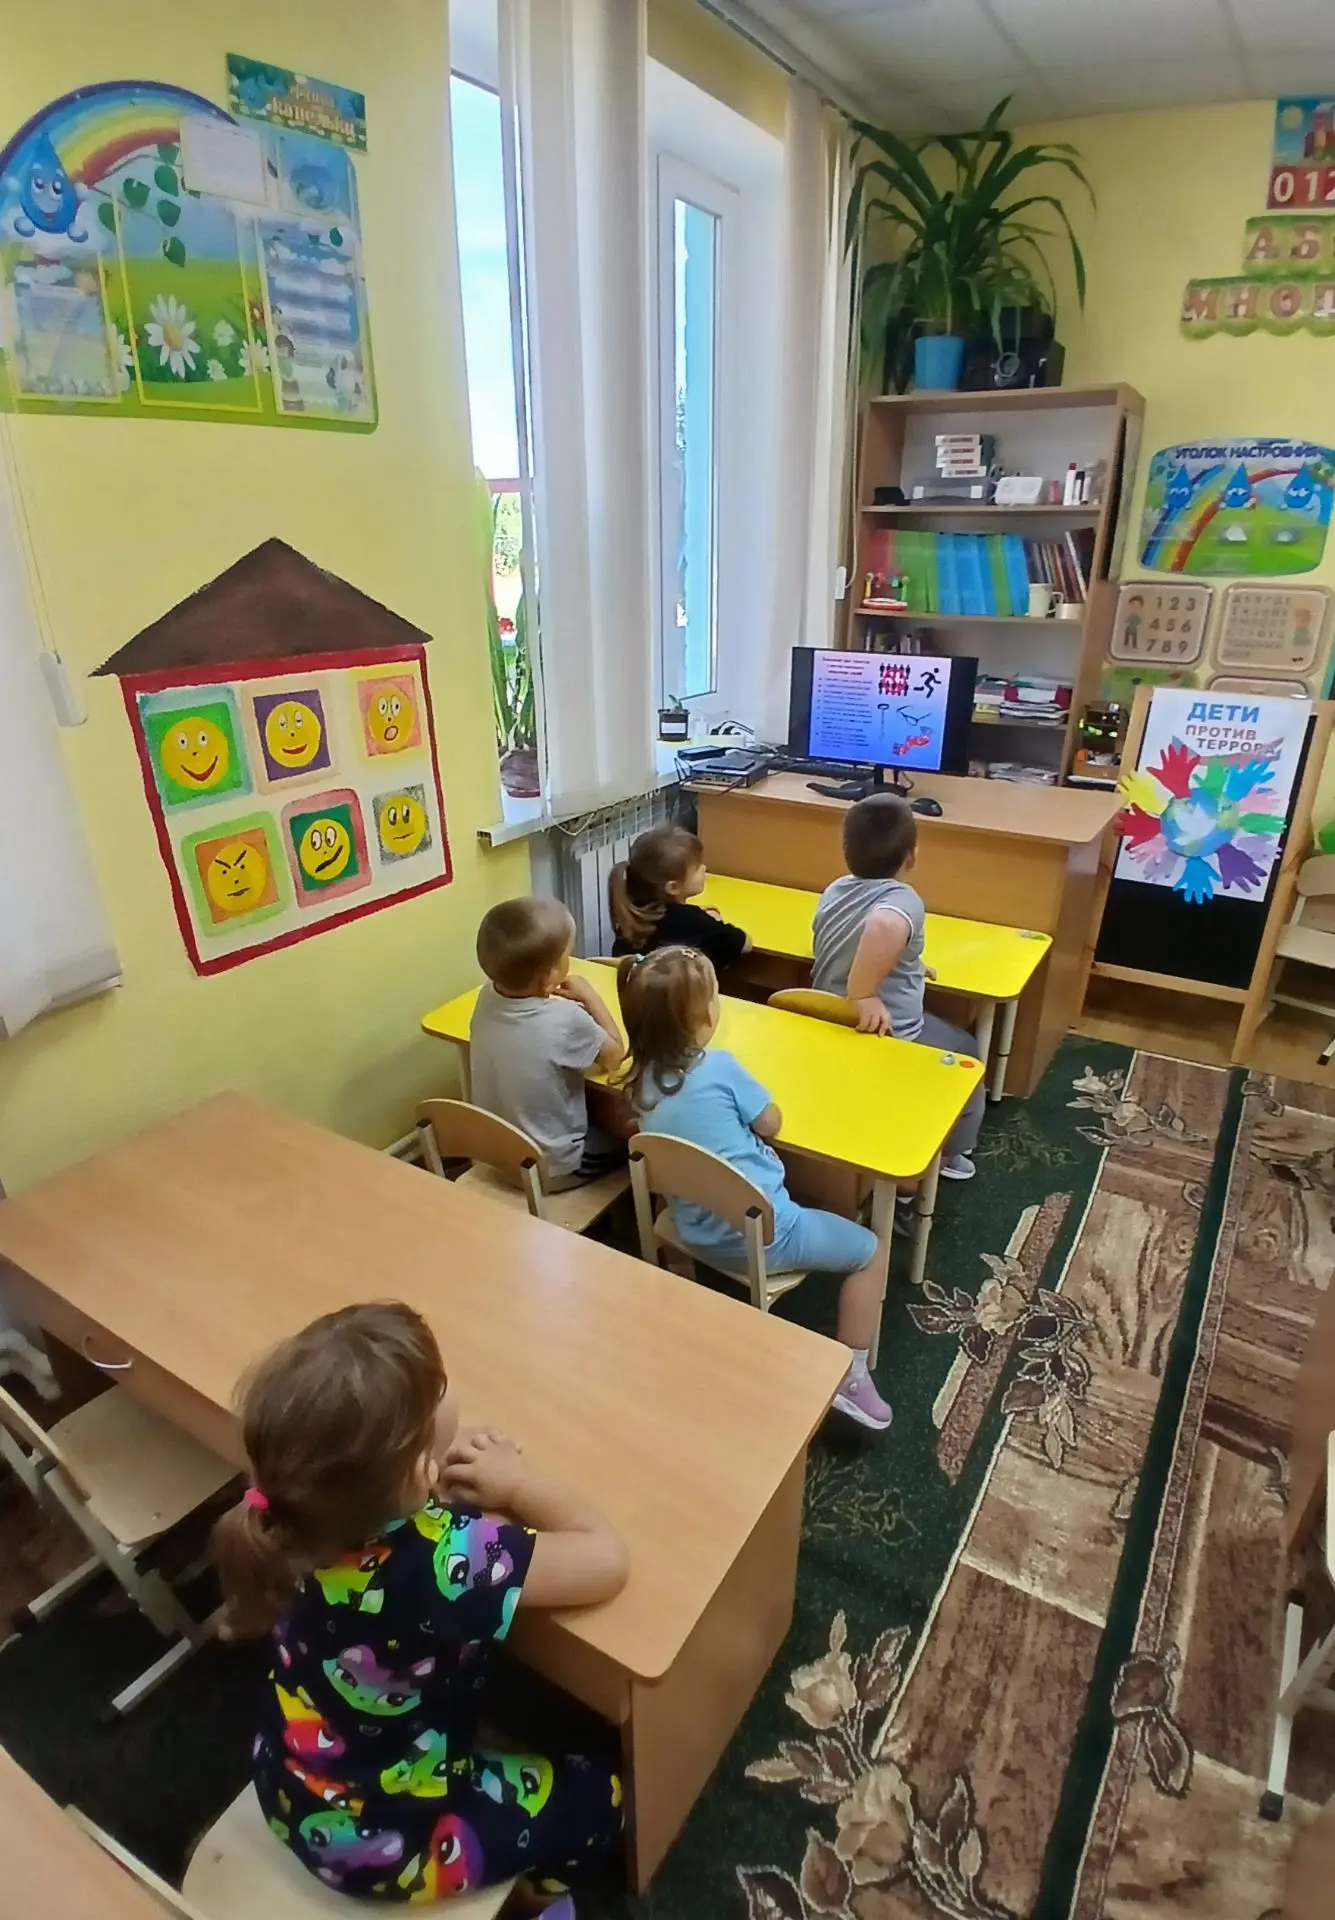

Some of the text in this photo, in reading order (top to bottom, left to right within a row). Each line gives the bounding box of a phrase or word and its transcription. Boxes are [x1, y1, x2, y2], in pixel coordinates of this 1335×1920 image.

[1175, 446, 1227, 459] УГОЛОК
[1169, 597, 1180, 611] 2
[1185, 597, 1196, 611] 3
[1148, 617, 1192, 633] 4 5 6
[1145, 639, 1188, 654] 7 8 9
[1187, 702, 1260, 723] ДЕТИ
[1185, 724, 1257, 741] ПРОТИВ
